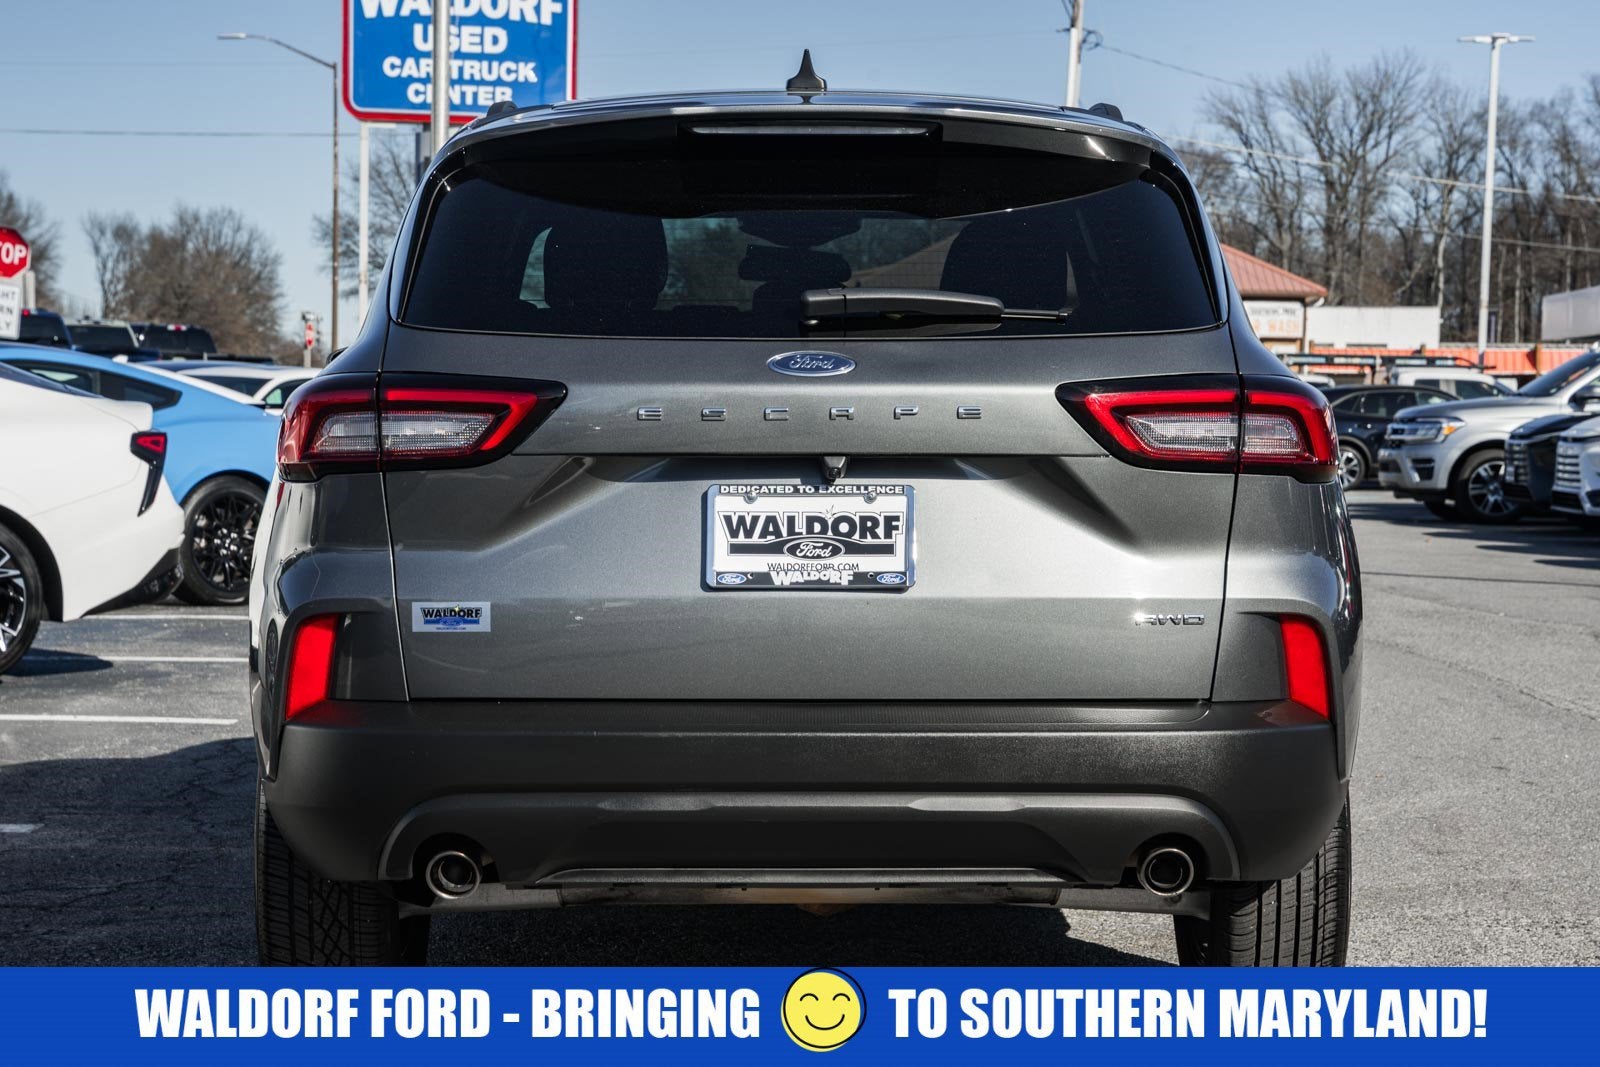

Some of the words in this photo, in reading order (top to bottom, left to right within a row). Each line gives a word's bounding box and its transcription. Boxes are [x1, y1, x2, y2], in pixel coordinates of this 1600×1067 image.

[361, 0, 563, 25] WADORF
[449, 59, 538, 83] TRUCK
[789, 354, 836, 369] Ford
[636, 406, 982, 420] ESCAPE
[720, 485, 794, 494] DEDICATED
[797, 485, 815, 494] TO
[818, 485, 903, 494] EXCELLENCE
[721, 514, 901, 540] WALDORF
[796, 541, 832, 558] Ford
[769, 570, 854, 586] WALDORF
[422, 608, 482, 618] WALDORF
